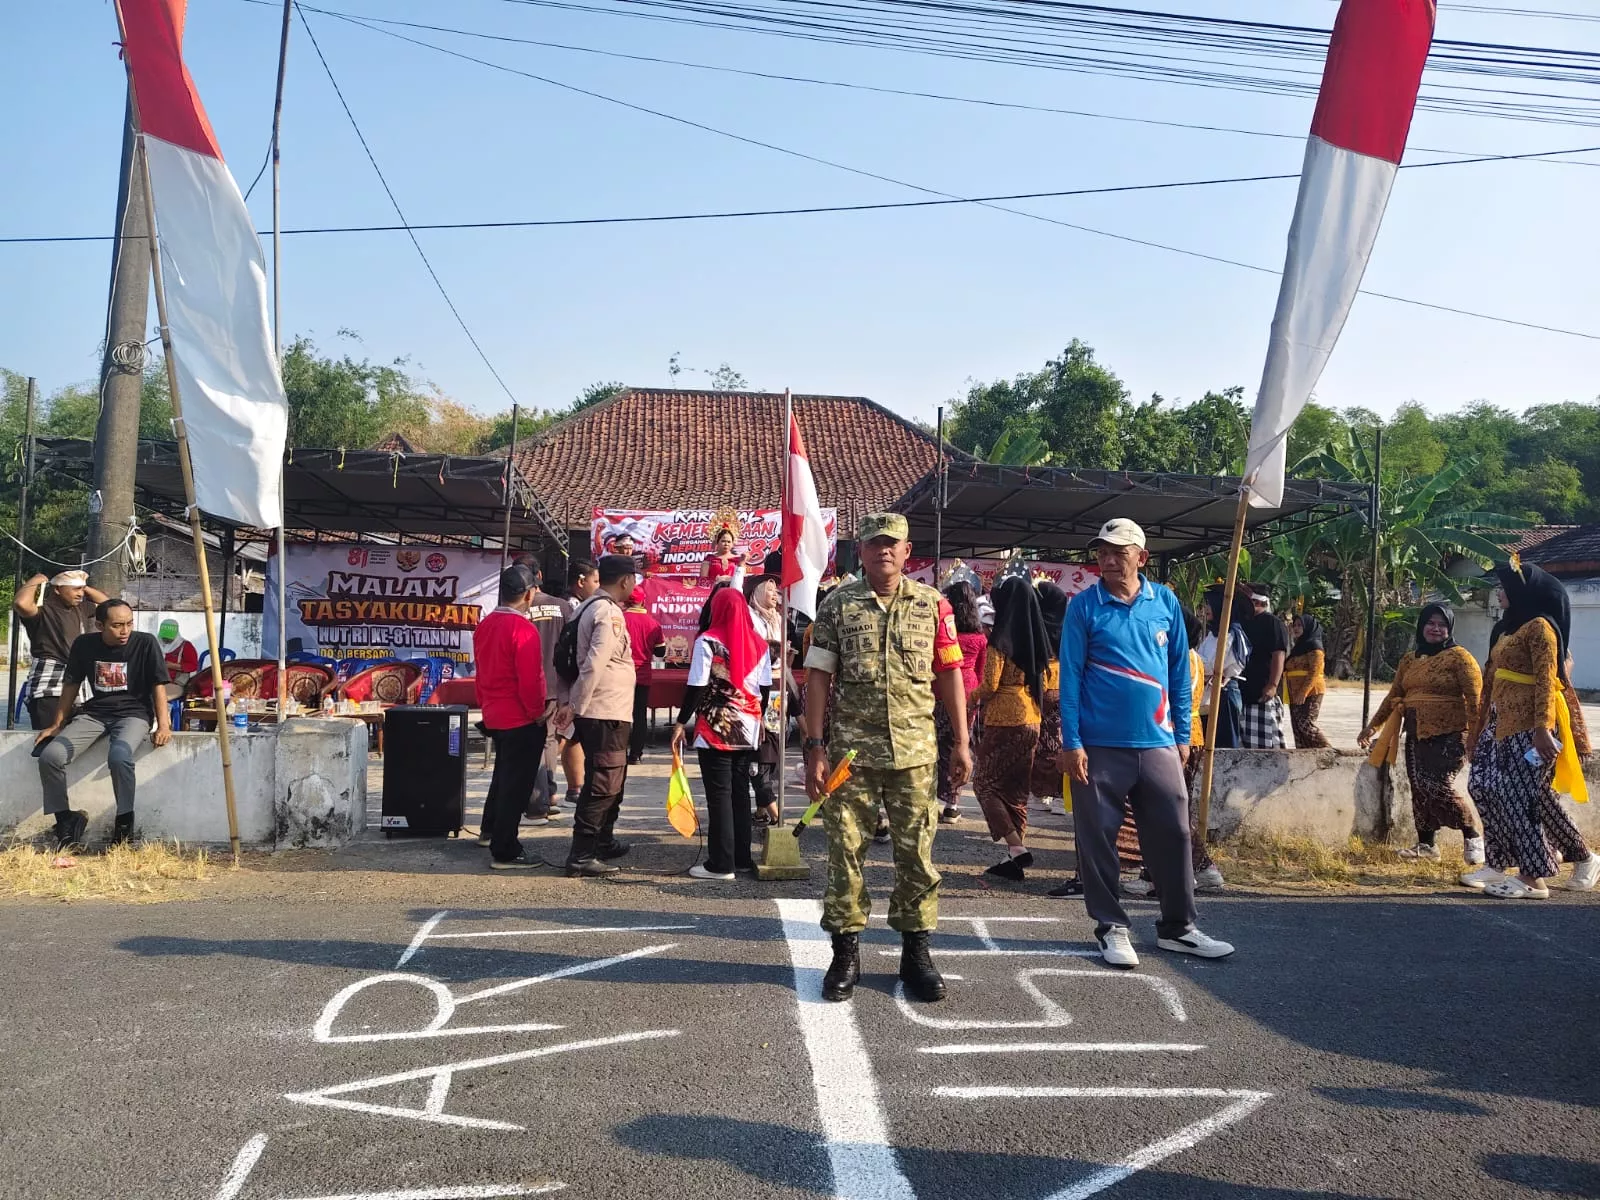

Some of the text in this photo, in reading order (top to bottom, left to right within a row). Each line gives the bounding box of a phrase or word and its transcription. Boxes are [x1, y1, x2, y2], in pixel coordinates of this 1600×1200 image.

[652, 520, 776, 543] KEMERAAN
[329, 572, 455, 598] MALAM
[300, 601, 481, 626] TASYAKURAN
[318, 626, 461, 648] HUT RI KE-81 TAHUN
[842, 623, 873, 636] SUMADI
[906, 623, 921, 631] TNI
[346, 648, 395, 660] BERSAMA
